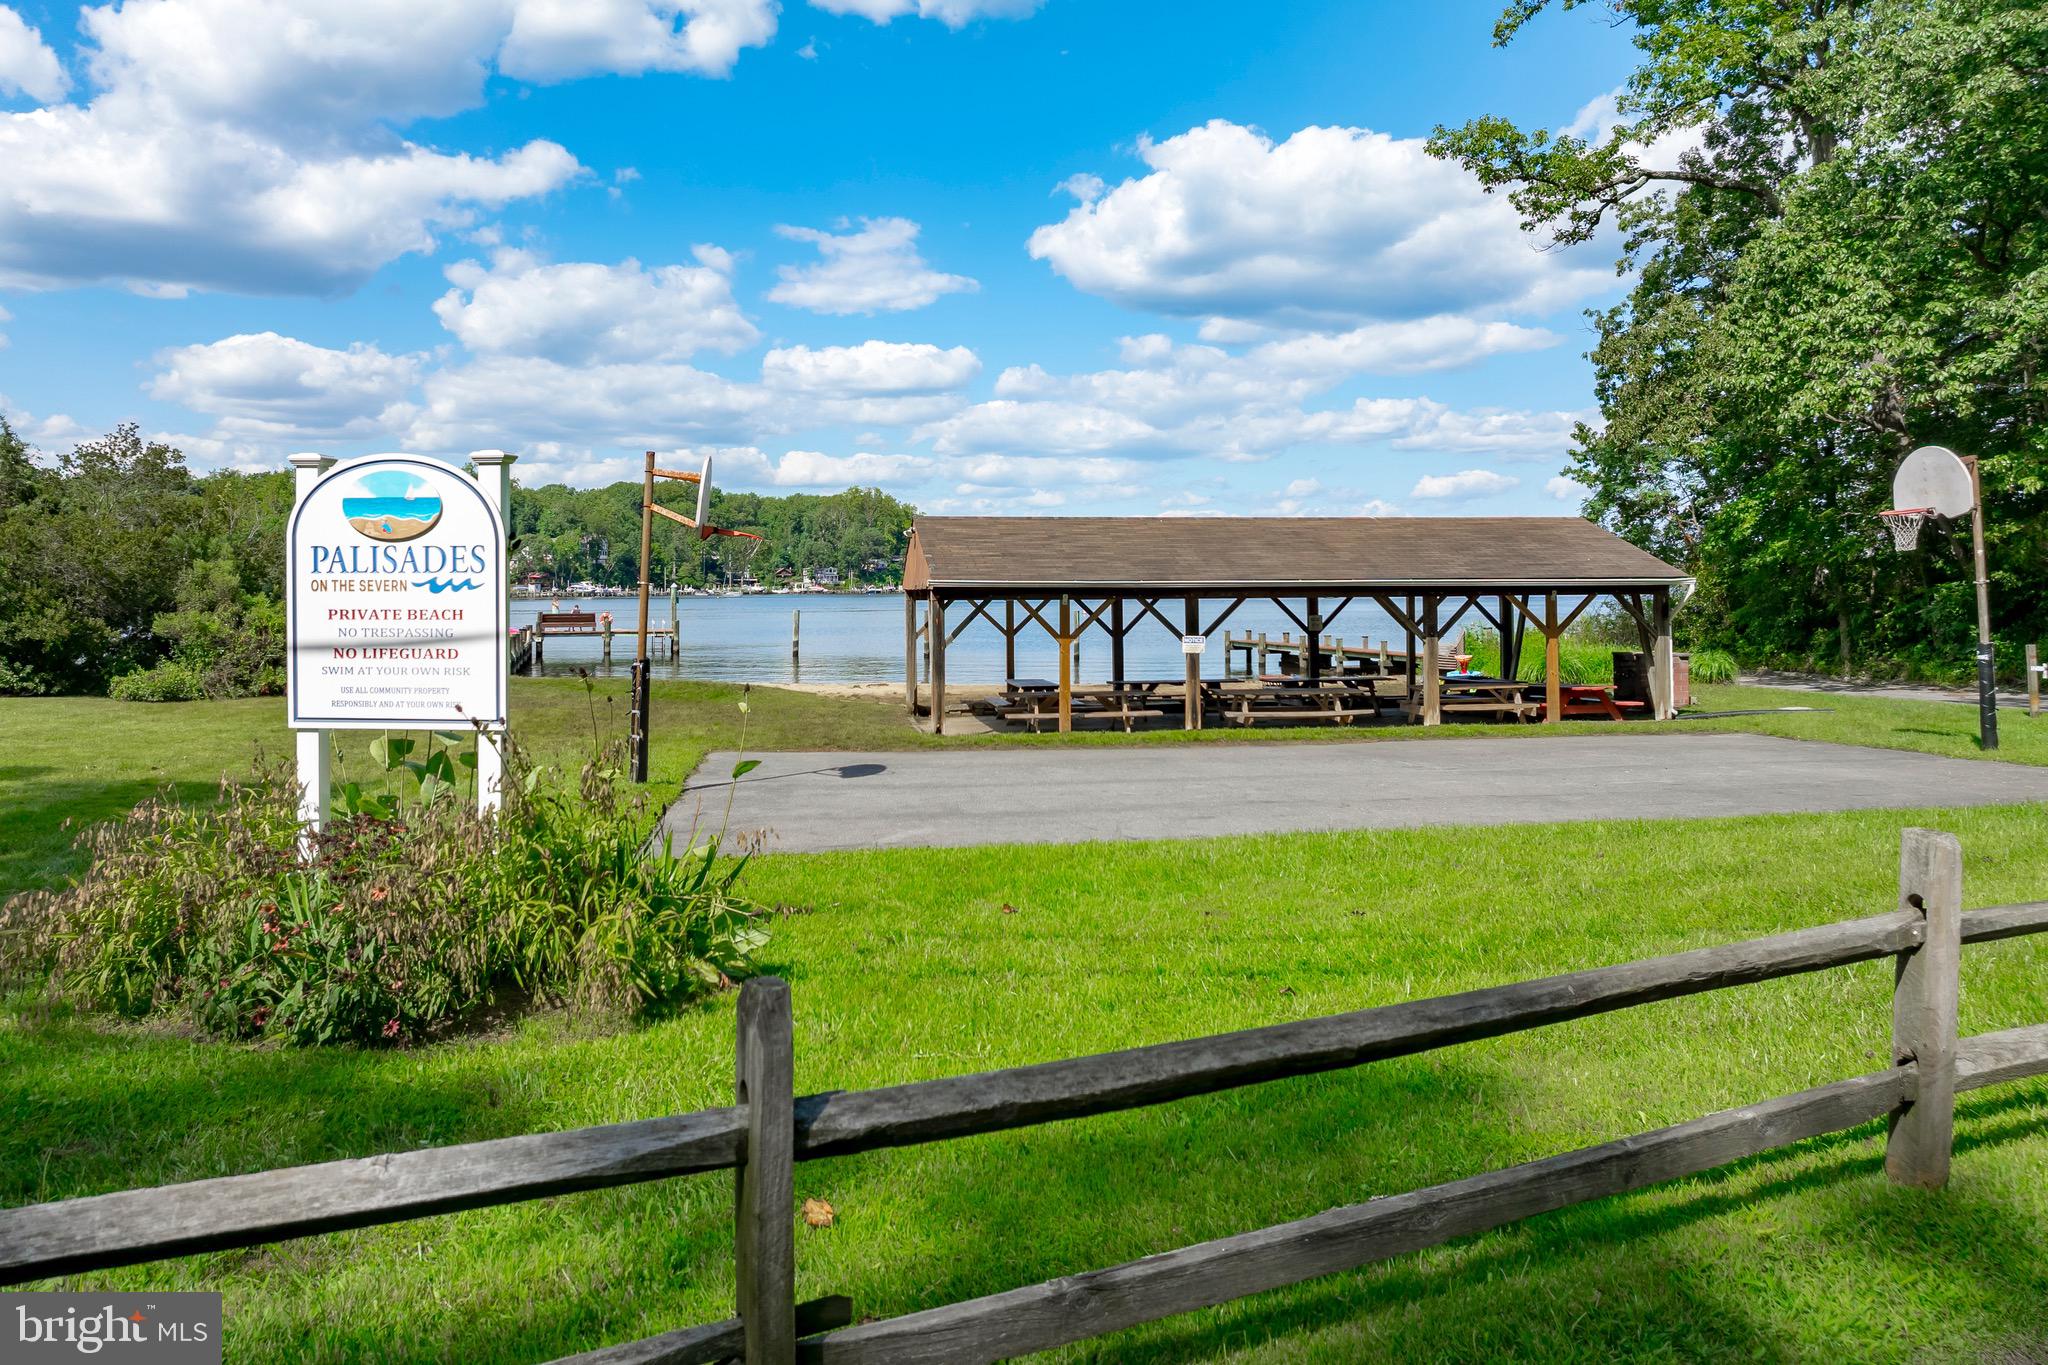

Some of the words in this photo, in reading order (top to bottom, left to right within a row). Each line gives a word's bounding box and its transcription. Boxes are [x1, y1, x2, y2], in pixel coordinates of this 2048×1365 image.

[310, 545, 485, 574] PALISADES
[311, 580, 327, 592] ON
[332, 580, 355, 592] THE
[359, 580, 407, 592] SEVERN
[328, 609, 402, 621] PRIVATE
[407, 609, 463, 621] BEACH
[338, 628, 357, 638] NO
[361, 628, 454, 638] TRESPASSING
[333, 648, 357, 659] NO
[363, 648, 459, 659] LIFEGUARD
[322, 667, 354, 675] SWIM
[358, 667, 373, 675] AT
[376, 667, 407, 675] YOUR
[412, 667, 440, 675] OWN
[444, 668, 470, 676] RISK
